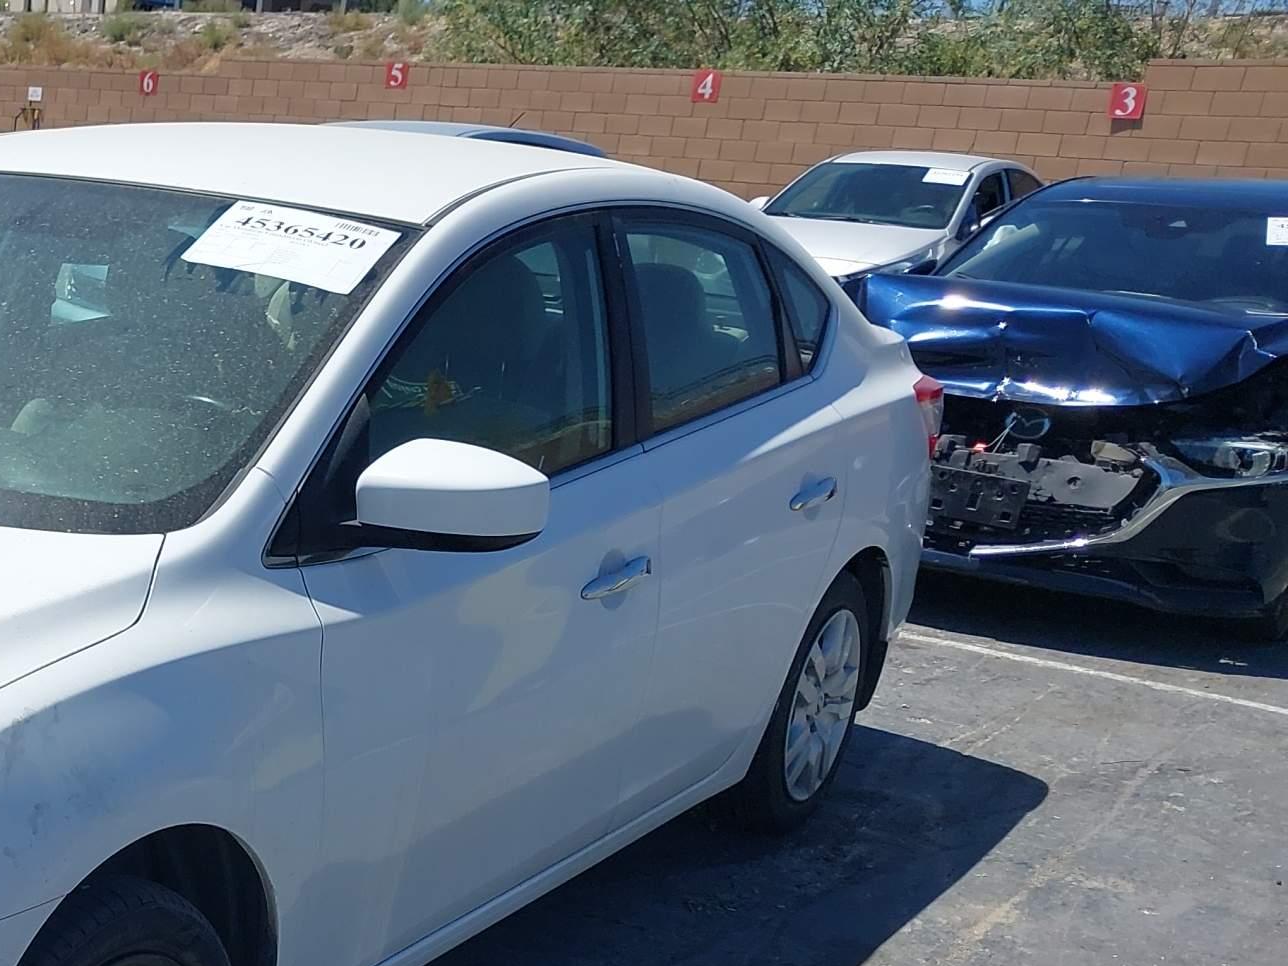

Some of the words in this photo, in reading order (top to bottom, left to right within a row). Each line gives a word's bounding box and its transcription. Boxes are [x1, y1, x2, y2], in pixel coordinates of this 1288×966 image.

[143, 71, 154, 93] 6
[389, 63, 403, 86] 5
[697, 72, 714, 99] 4
[1114, 86, 1137, 116] 3
[235, 215, 367, 250] 45365420
